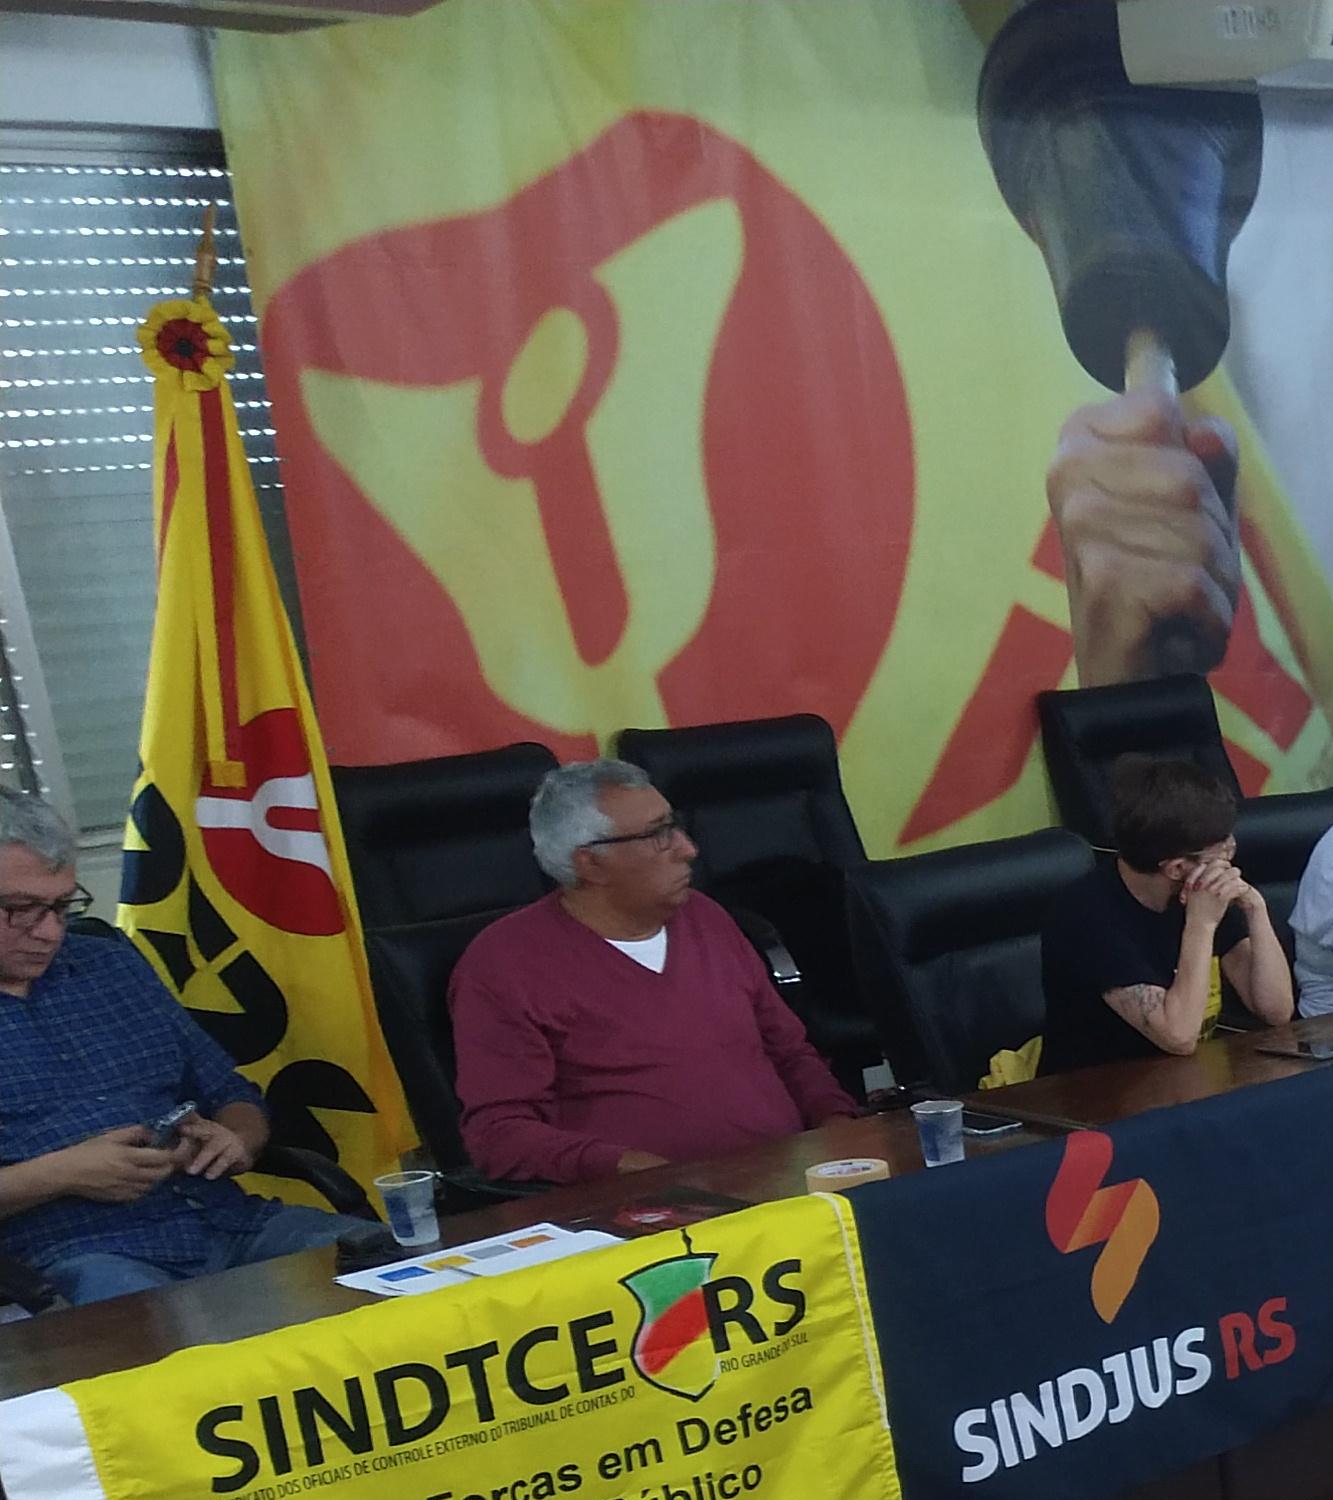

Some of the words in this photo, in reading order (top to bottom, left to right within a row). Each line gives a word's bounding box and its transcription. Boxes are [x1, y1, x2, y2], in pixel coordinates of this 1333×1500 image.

[195, 1310, 626, 1493] SINDTCE
[701, 1258, 806, 1354] RS
[278, 1477, 300, 1500] DOS
[303, 1466, 351, 1490] OFICIAIS
[354, 1460, 371, 1476] DE
[372, 1444, 435, 1473] CONTROLE
[436, 1430, 488, 1456] EXTERNO
[502, 1410, 558, 1436] TRIBUNAL
[560, 1404, 575, 1420] DE
[576, 1394, 618, 1415] CONTAS
[621, 1385, 636, 1402] DO
[720, 1356, 739, 1374] RIO
[597, 1436, 663, 1480] em
[676, 1386, 814, 1456] Defesa
[953, 1327, 1212, 1483] SINDJUS
[1218, 1296, 1296, 1380] RS
